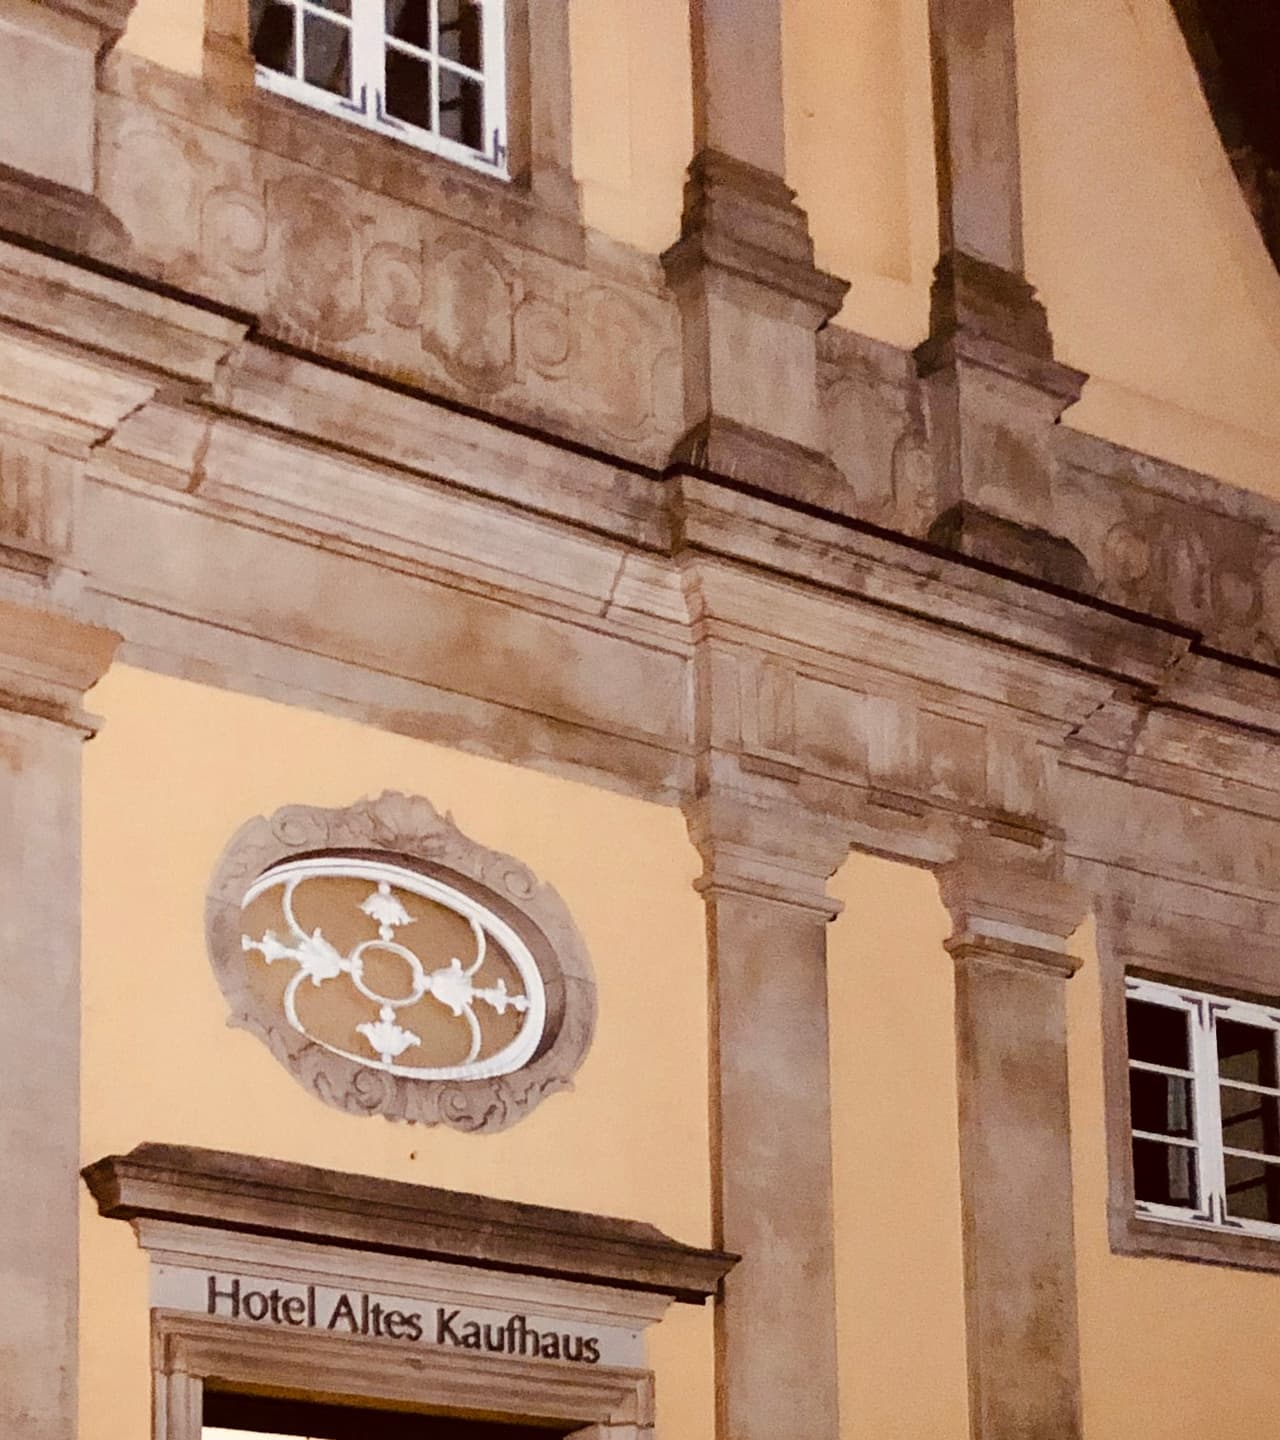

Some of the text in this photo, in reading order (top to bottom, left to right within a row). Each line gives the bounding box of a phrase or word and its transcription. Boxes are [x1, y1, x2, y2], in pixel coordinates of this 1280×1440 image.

[207, 1276, 601, 1364] Hotel Altes Kaufhaus
